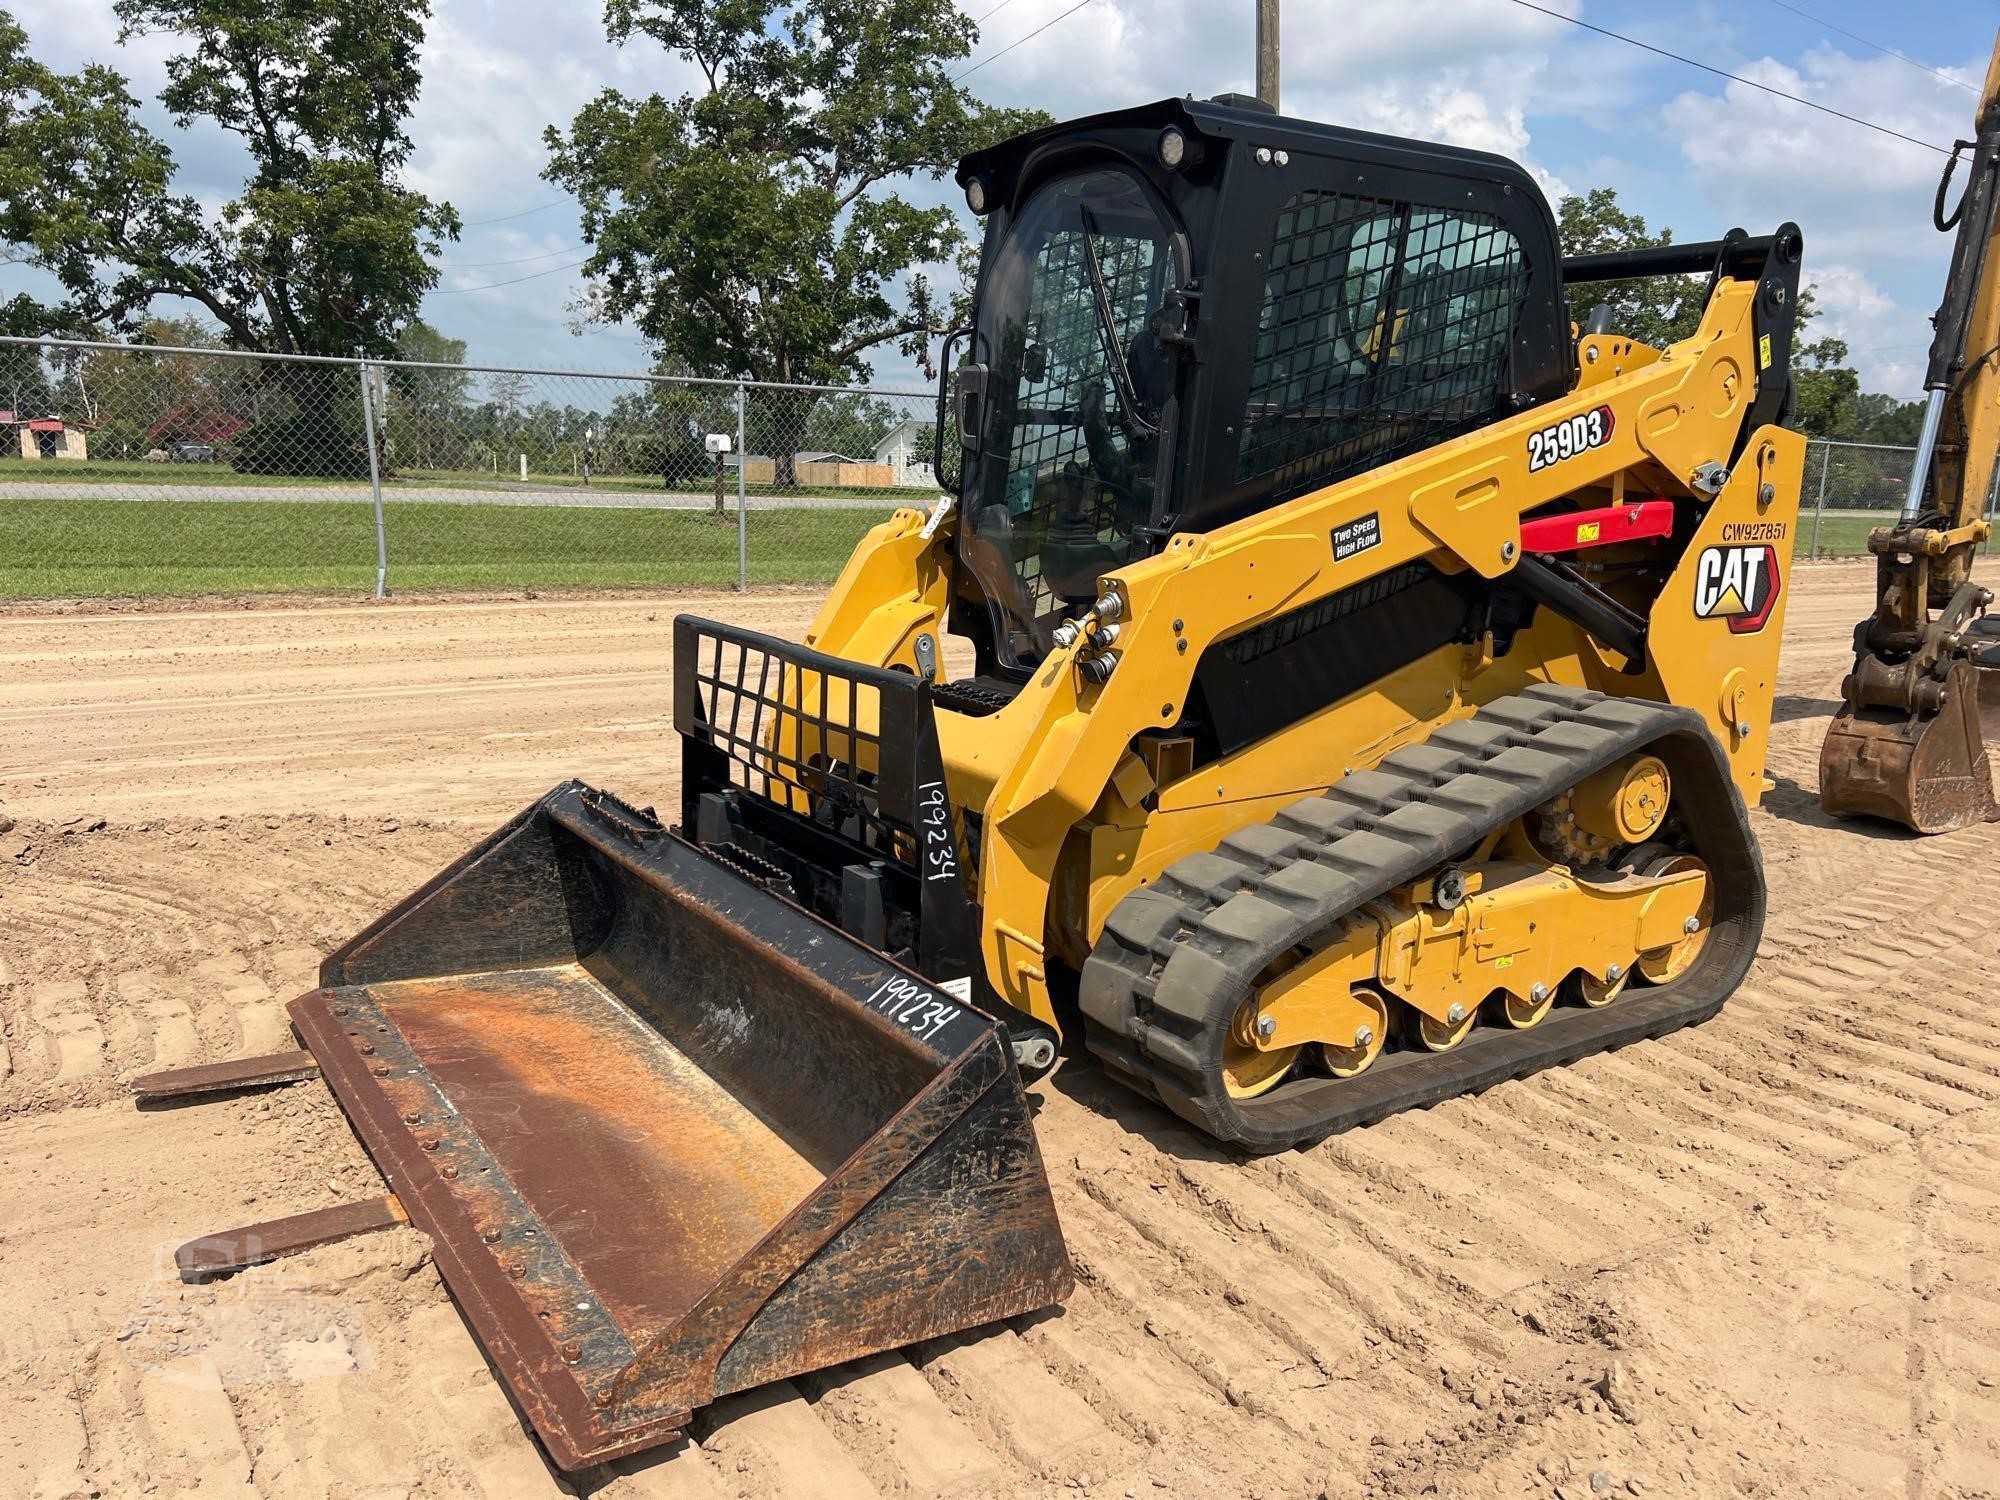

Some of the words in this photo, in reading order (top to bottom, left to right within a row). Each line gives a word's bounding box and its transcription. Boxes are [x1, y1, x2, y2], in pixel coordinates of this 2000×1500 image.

[1528, 410, 1602, 471] 259D3
[1333, 528, 1351, 543] TWO
[1352, 518, 1376, 537] SPEED
[1336, 541, 1356, 558] HIGH
[1356, 532, 1377, 550] FLOW
[1722, 523, 1786, 541] CW927851
[1695, 547, 1765, 616] CAT
[918, 781, 956, 881] 199234
[866, 976, 961, 1041] 199234
